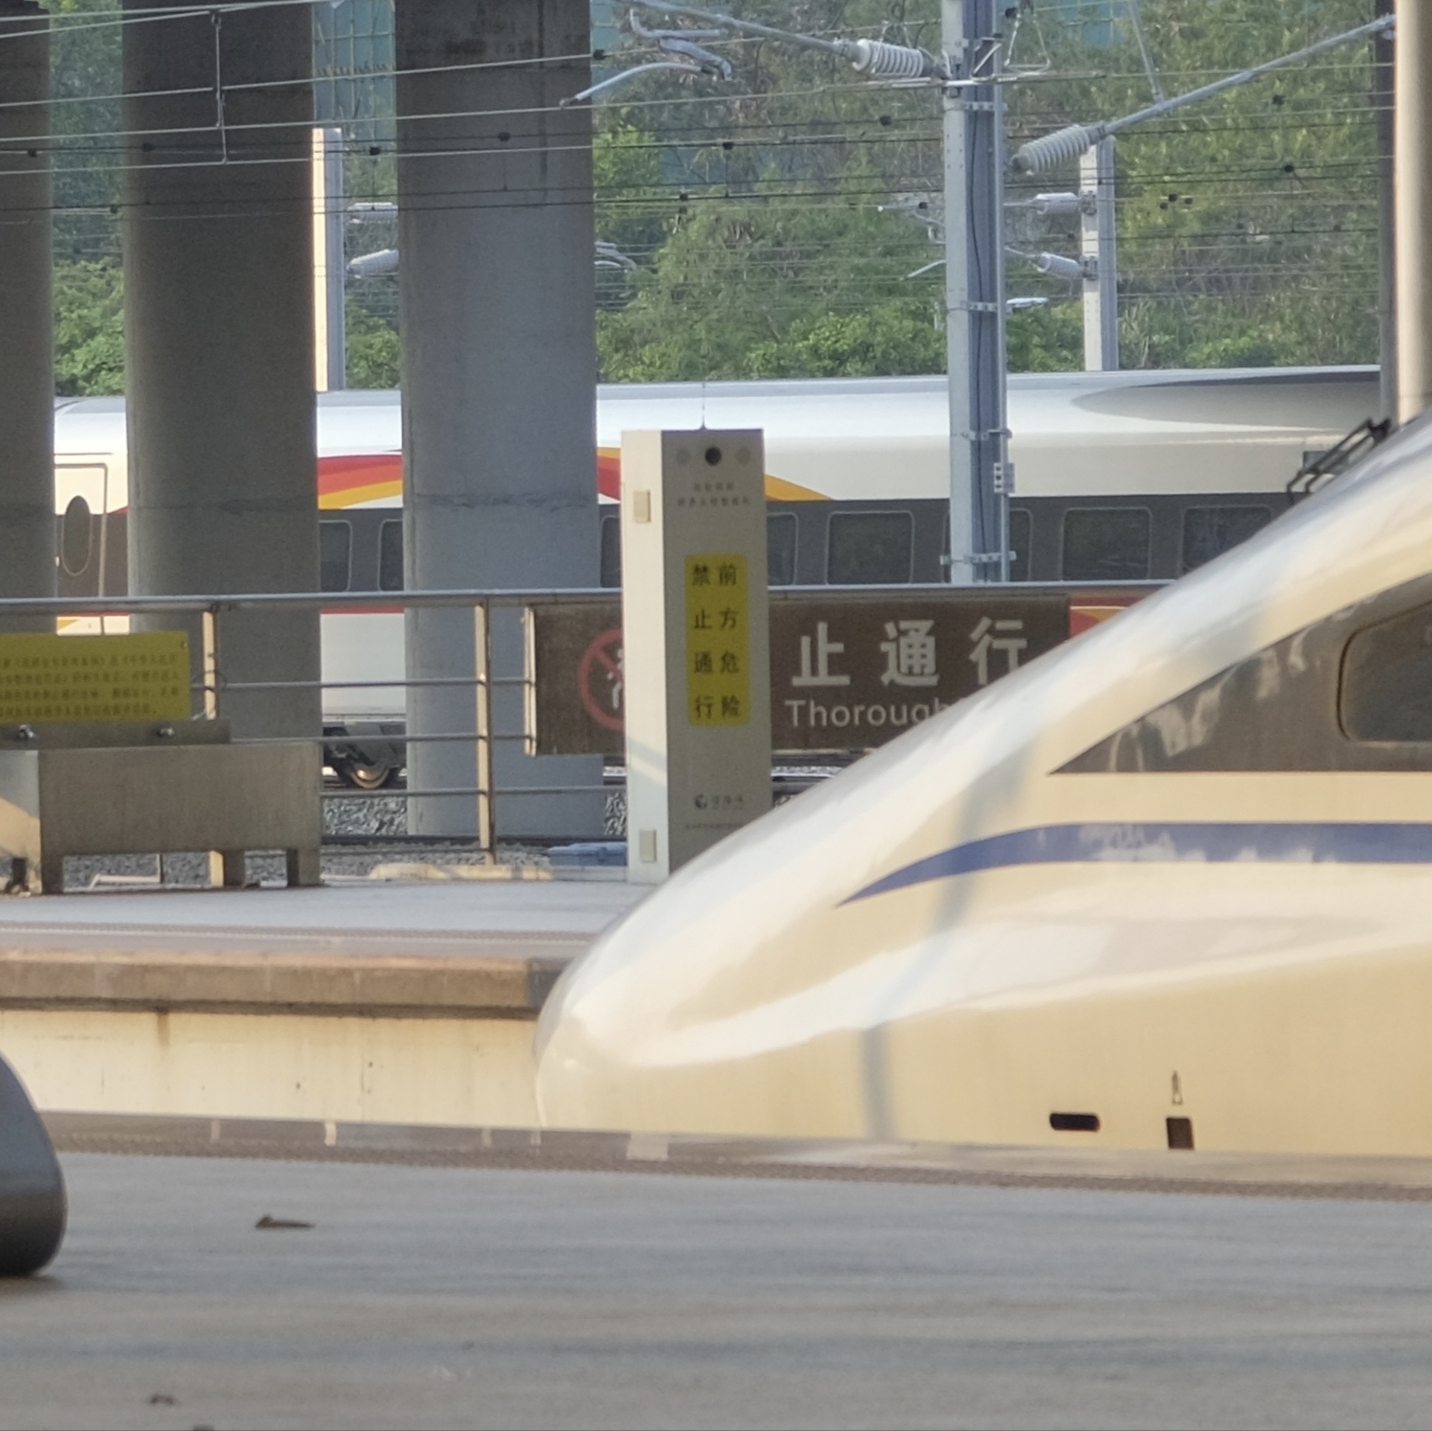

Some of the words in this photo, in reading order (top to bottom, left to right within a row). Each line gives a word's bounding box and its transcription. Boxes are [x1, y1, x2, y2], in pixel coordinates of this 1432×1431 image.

[692, 563, 714, 719] 禁止通行
[719, 562, 740, 717] 前方危险
